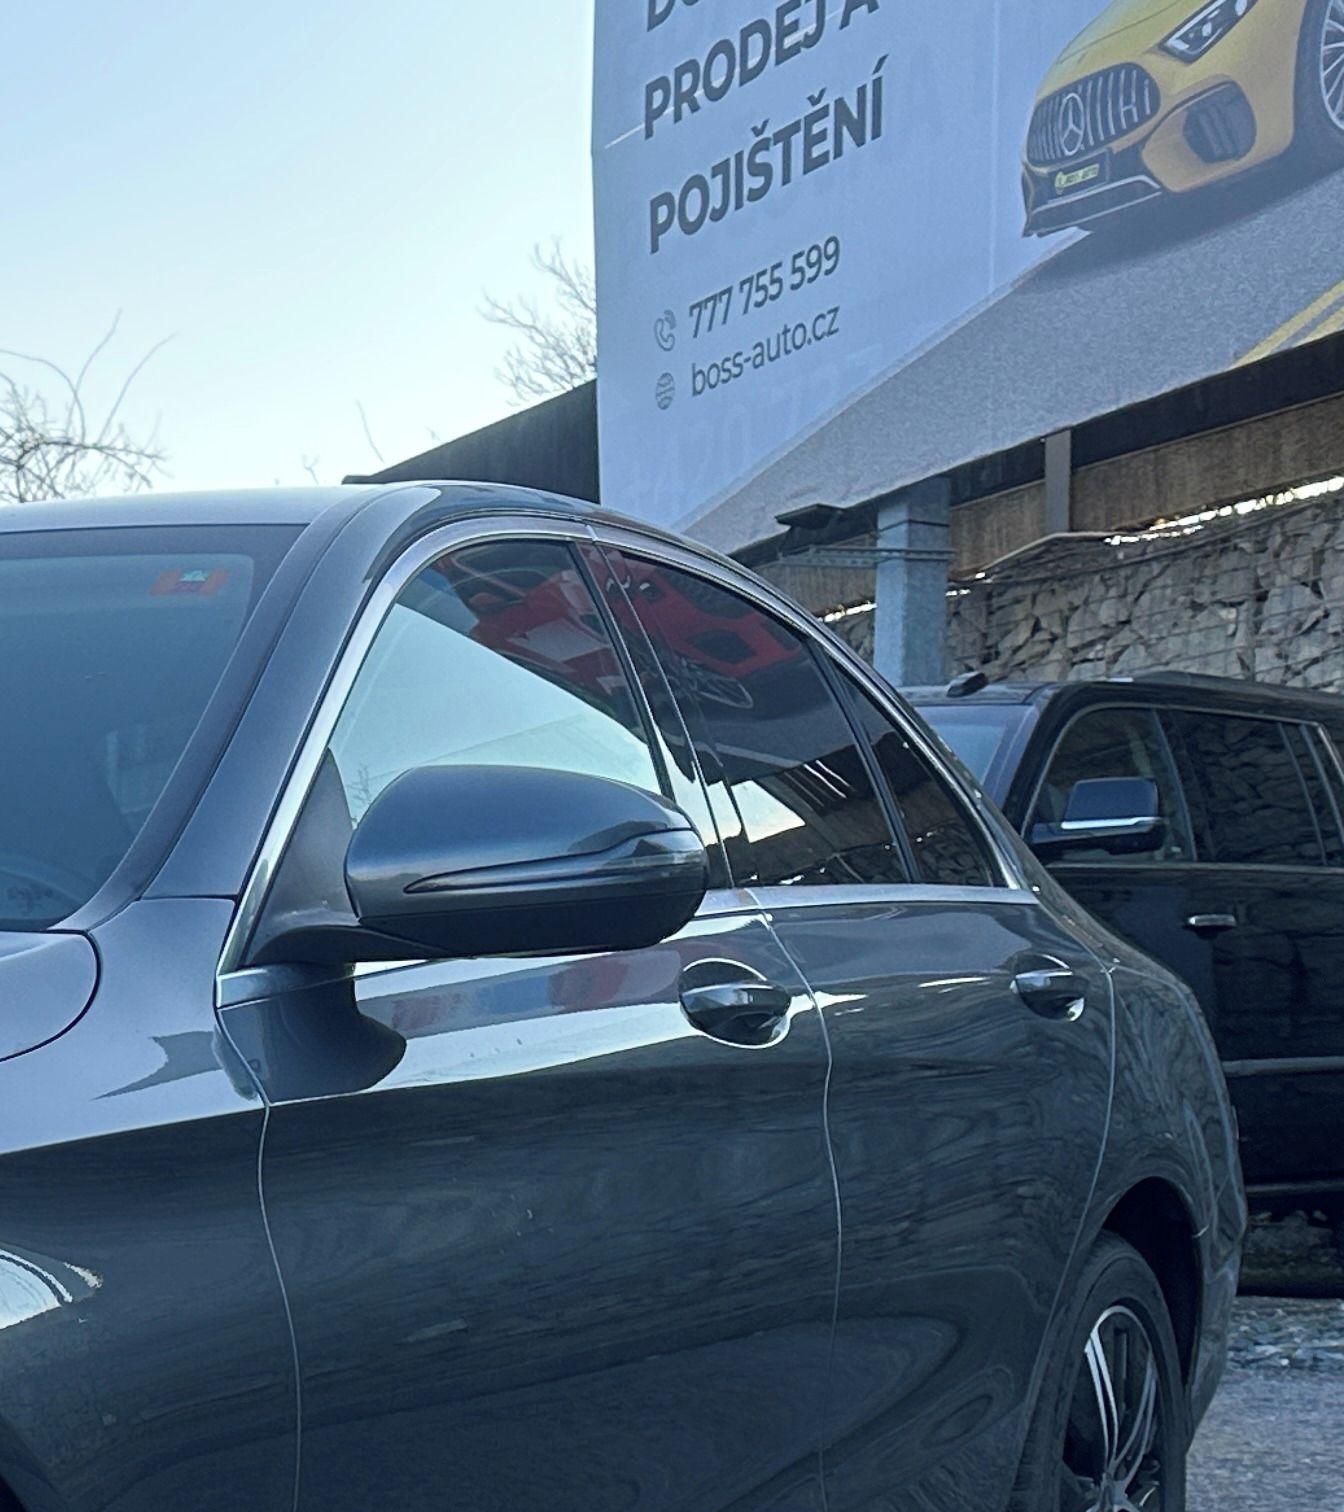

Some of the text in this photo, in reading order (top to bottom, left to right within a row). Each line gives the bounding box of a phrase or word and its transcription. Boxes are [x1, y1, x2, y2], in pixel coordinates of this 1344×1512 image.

[645, 0, 826, 140] PRODEJ
[650, 53, 889, 254] POJIŠTĚNÍ
[689, 236, 840, 339] 777 755 599
[692, 306, 840, 397] boss-auto.cz
